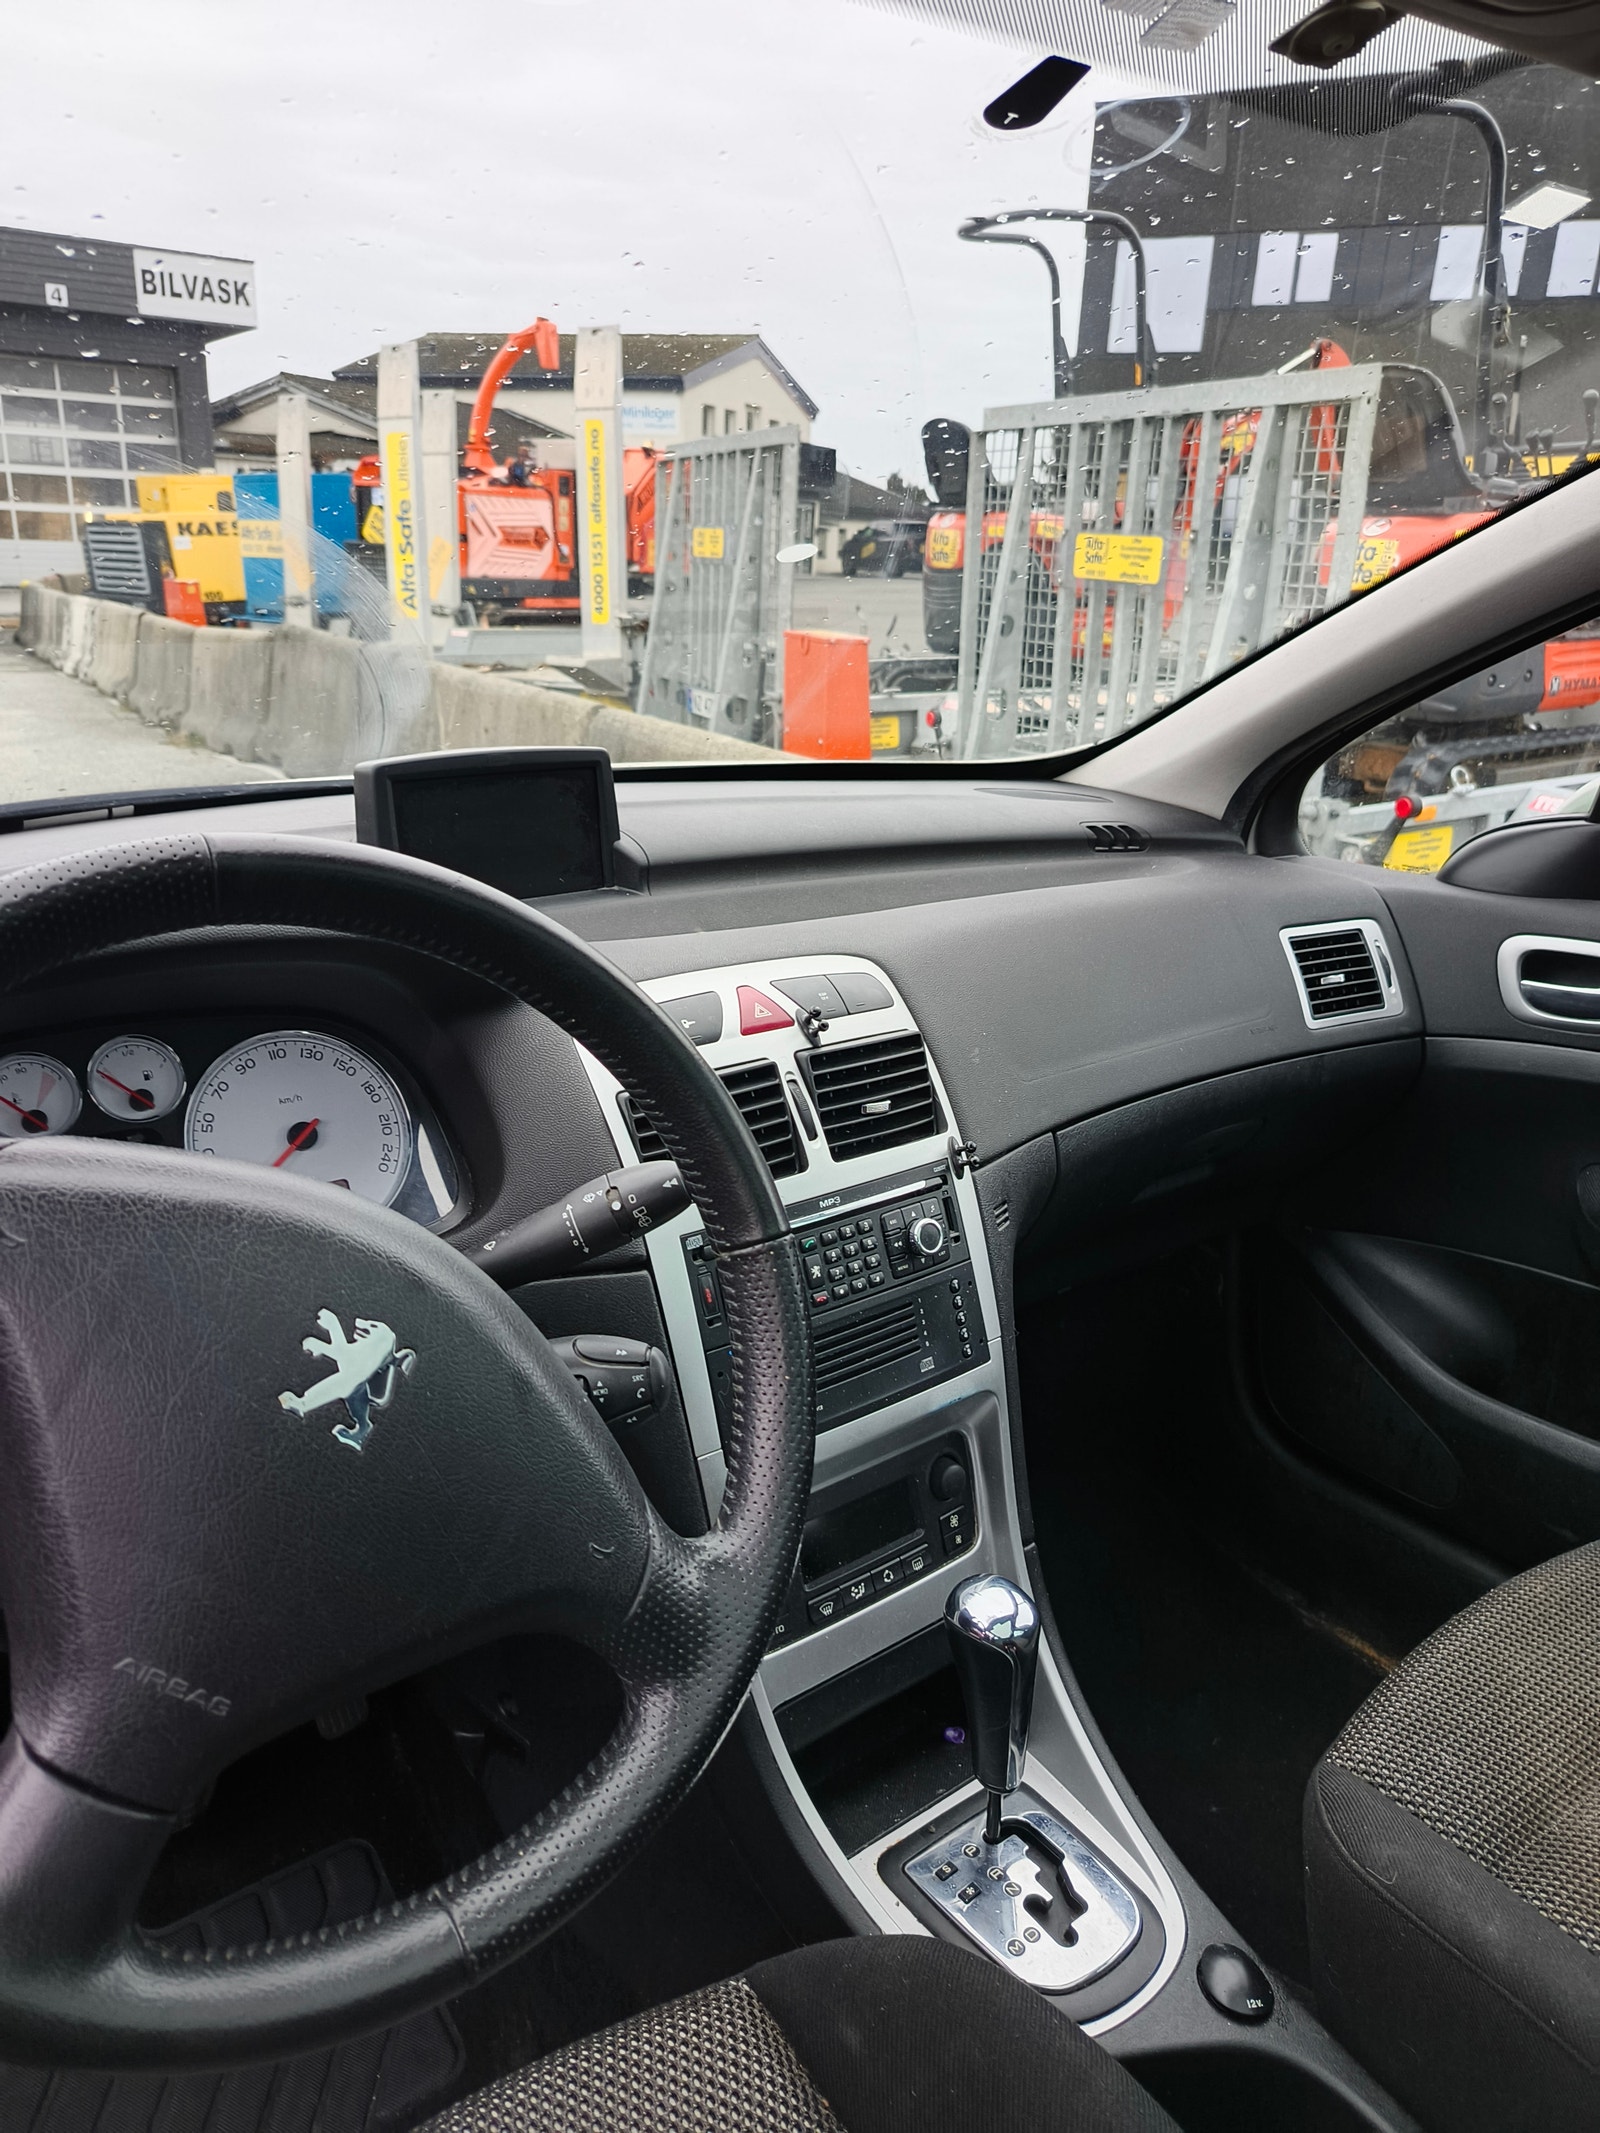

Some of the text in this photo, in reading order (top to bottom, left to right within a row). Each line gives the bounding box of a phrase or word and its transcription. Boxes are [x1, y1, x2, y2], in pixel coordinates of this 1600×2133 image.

[51, 287, 62, 303] 4
[141, 269, 250, 306] BILVASK
[397, 500, 414, 556] Safe
[588, 428, 604, 616] 4000 1551 alfasafe.no
[402, 564, 417, 611] Alfa
[267, 1048, 287, 1061] 110
[300, 1048, 324, 1061] 130
[234, 1058, 257, 1075] 90
[332, 1057, 358, 1077] 150
[211, 1081, 230, 1100] 70
[278, 1094, 304, 1105] km/h
[360, 1080, 382, 1104] 180
[201, 1112, 215, 1133] 50
[378, 1113, 393, 1136] 210
[378, 1143, 393, 1173] 240
[818, 1195, 841, 1209] MP3
[631, 1374, 645, 1382] SRC
[112, 1657, 232, 1717] AIRBAG
[965, 1846, 977, 1857] P
[1005, 1883, 1019, 1895] N
[1024, 1929, 1038, 1942] D
[1009, 1941, 1023, 1951] M
